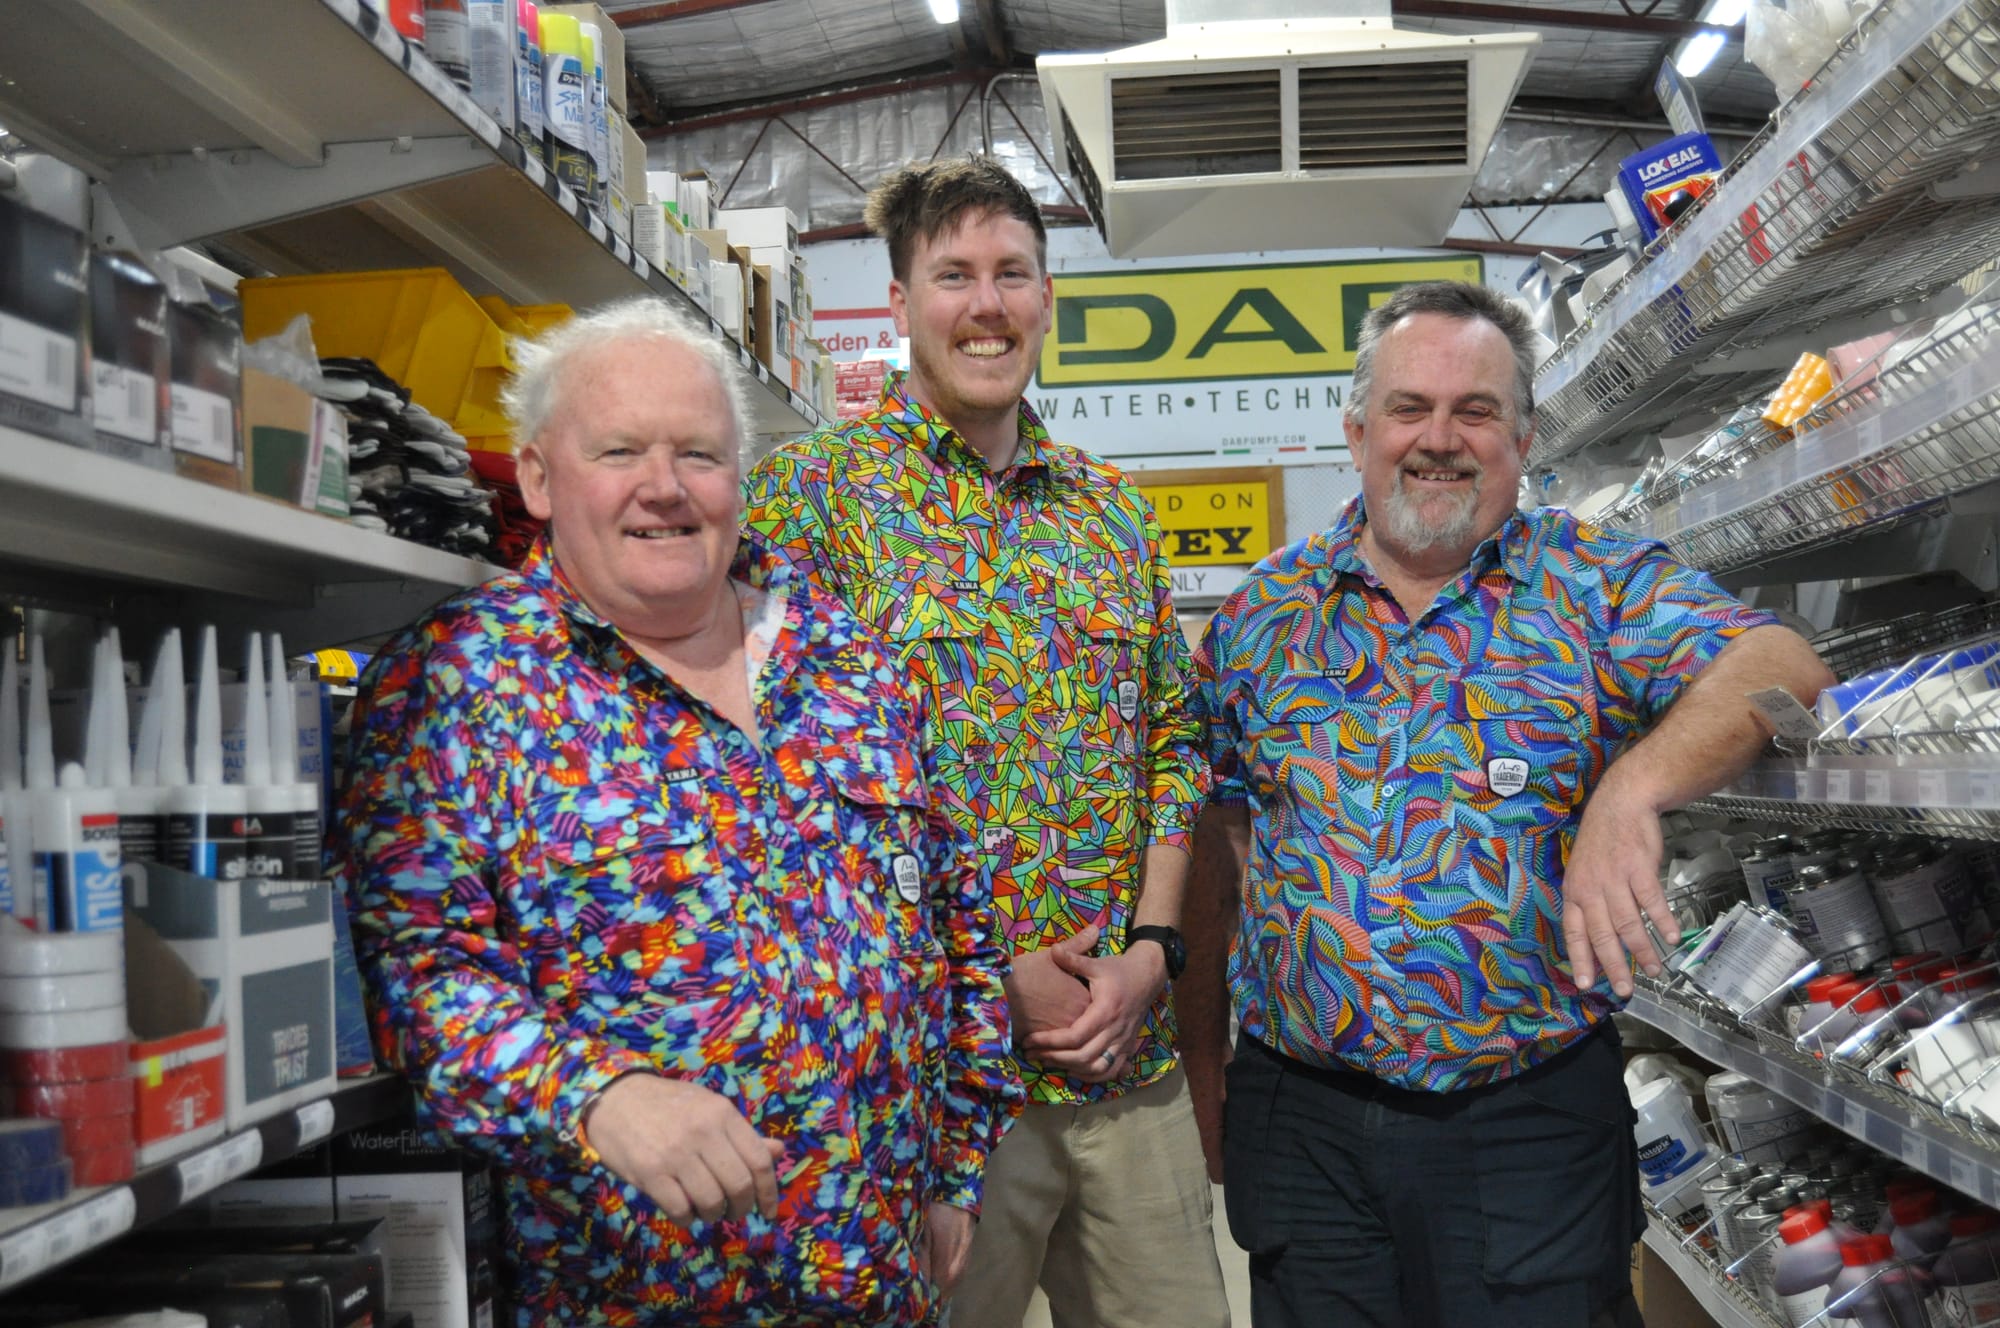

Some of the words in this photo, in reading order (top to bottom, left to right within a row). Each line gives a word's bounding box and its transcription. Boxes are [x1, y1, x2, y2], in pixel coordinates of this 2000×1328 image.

[1637, 147, 1701, 182] LOXEAL
[1221, 434, 1307, 447] DABPUMPS.COM
[1210, 493, 1253, 510] ON
